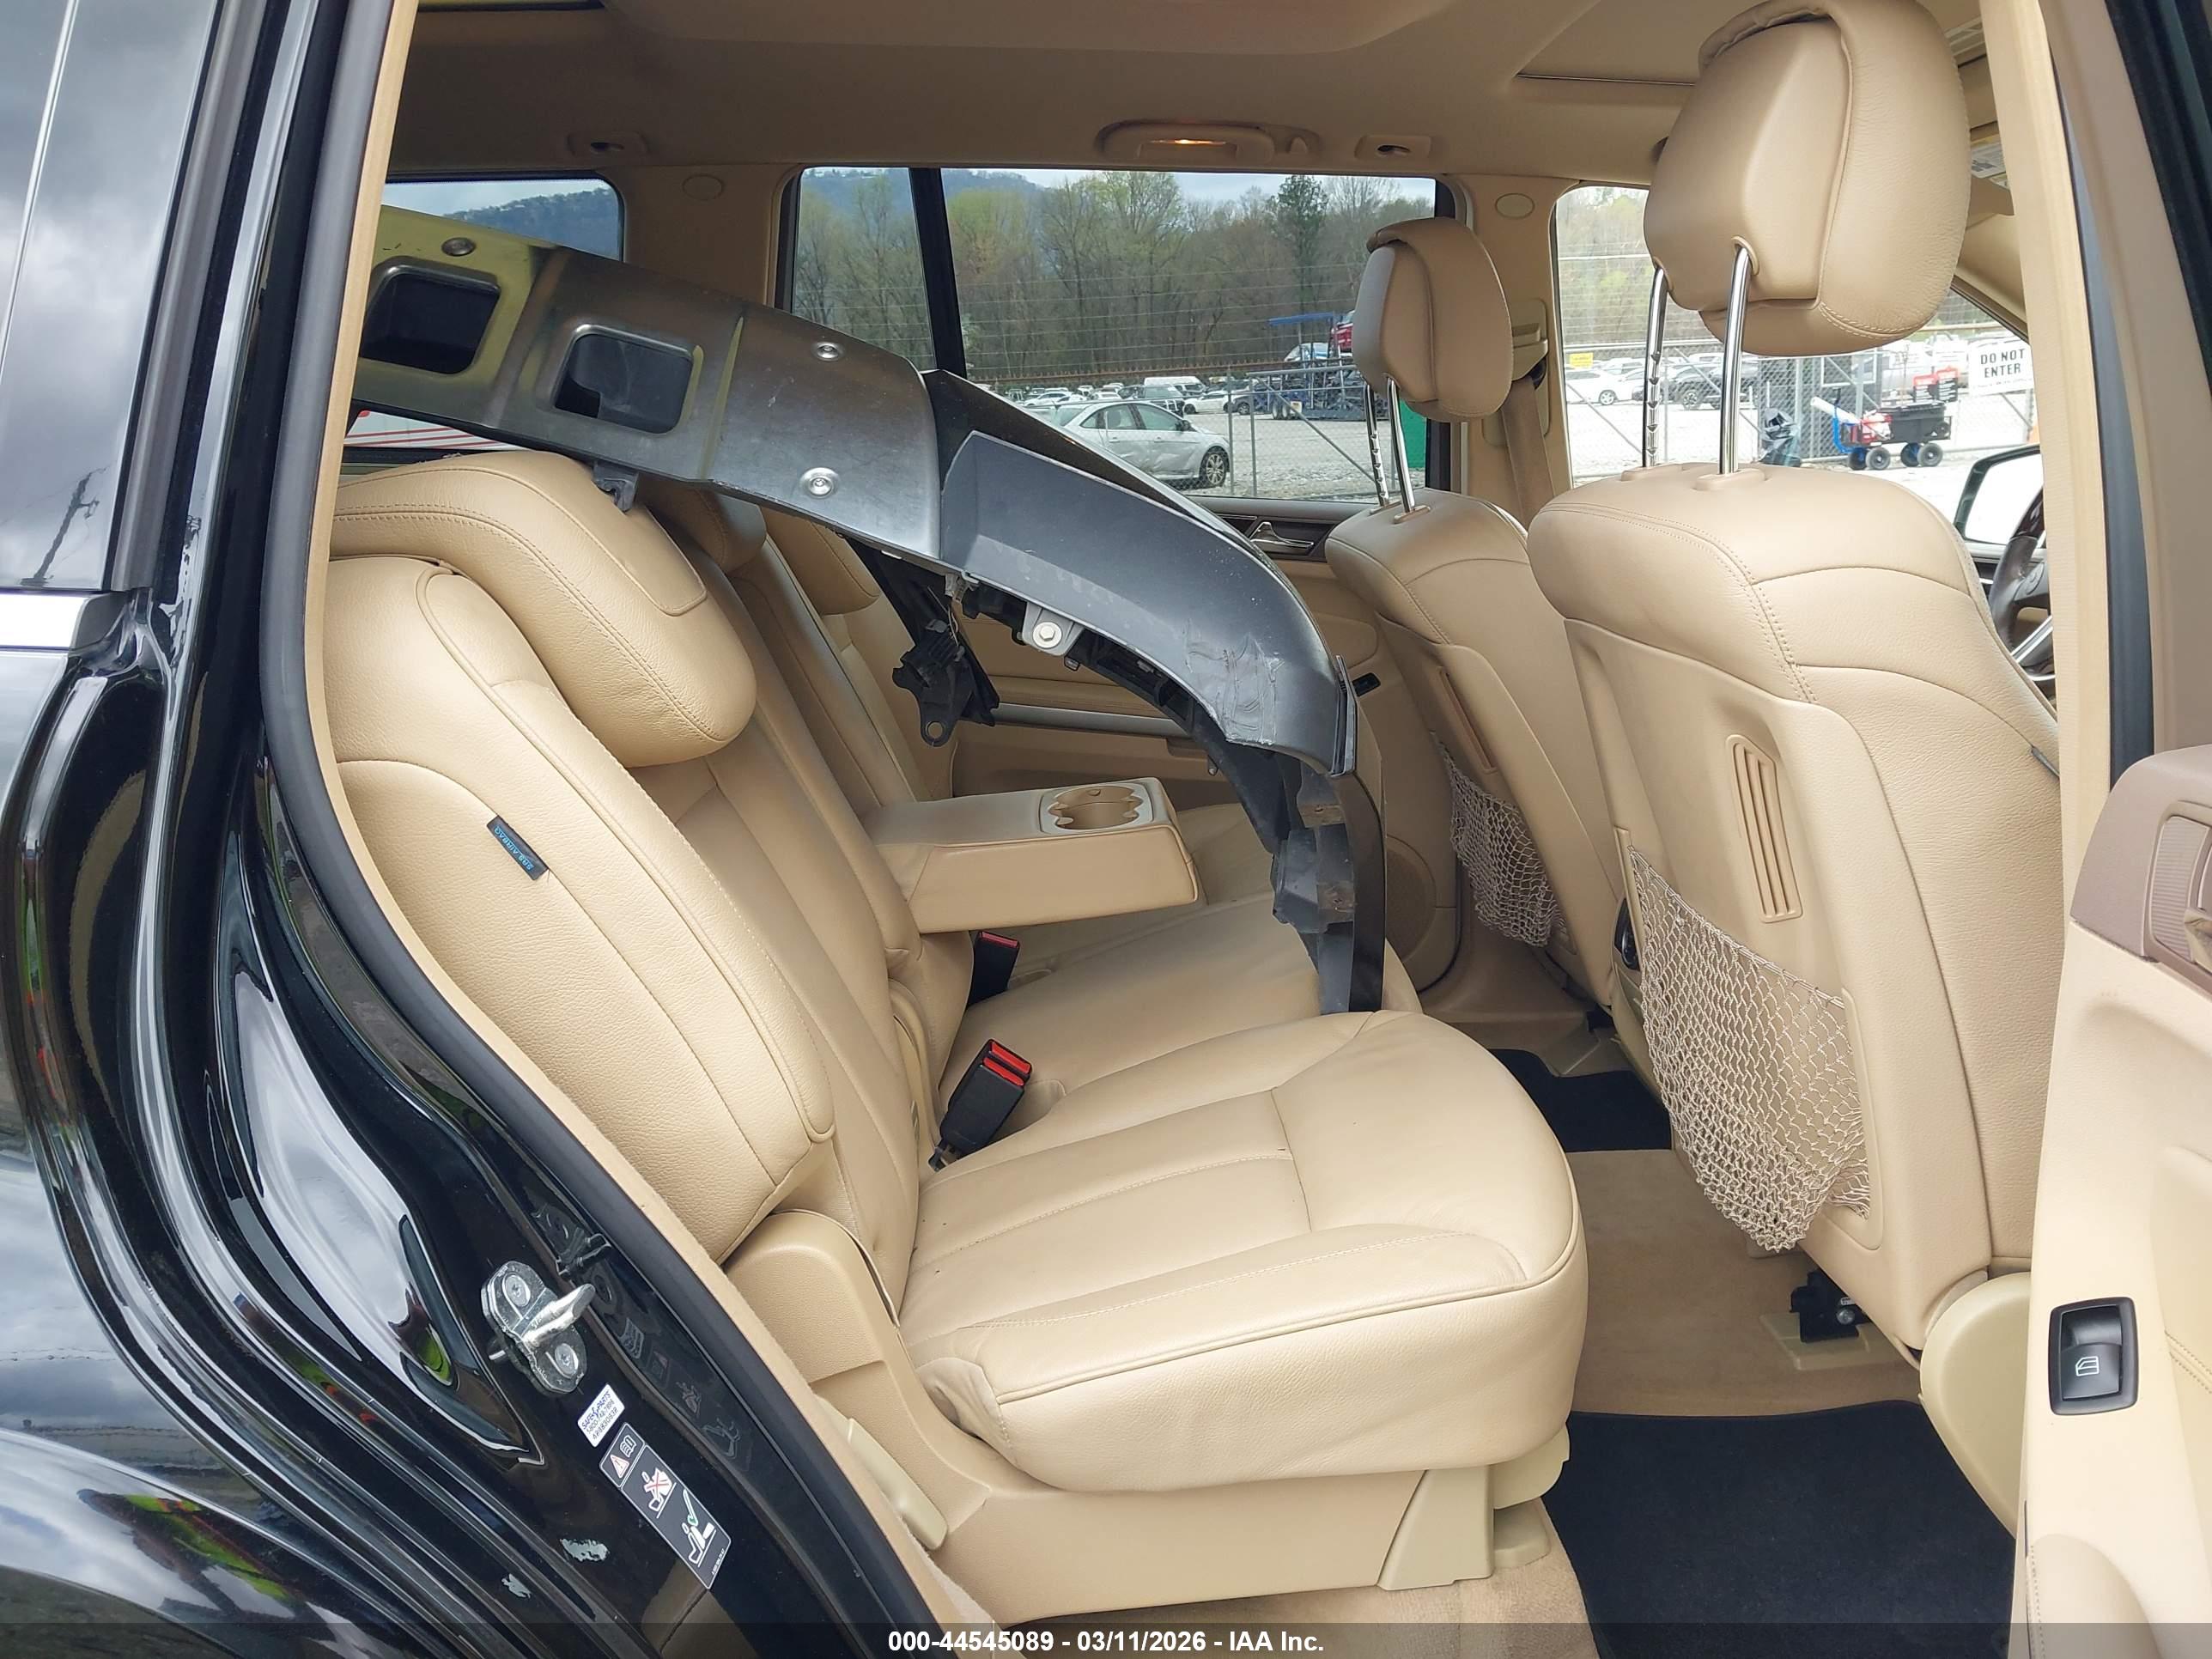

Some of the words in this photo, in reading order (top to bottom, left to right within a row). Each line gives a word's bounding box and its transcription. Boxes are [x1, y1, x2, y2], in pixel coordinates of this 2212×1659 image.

[1980, 353, 1996, 365] DO
[2001, 348, 2026, 362] NOT
[1984, 362, 2021, 378] ENTER
[494, 825, 522, 859] AIRBAG
